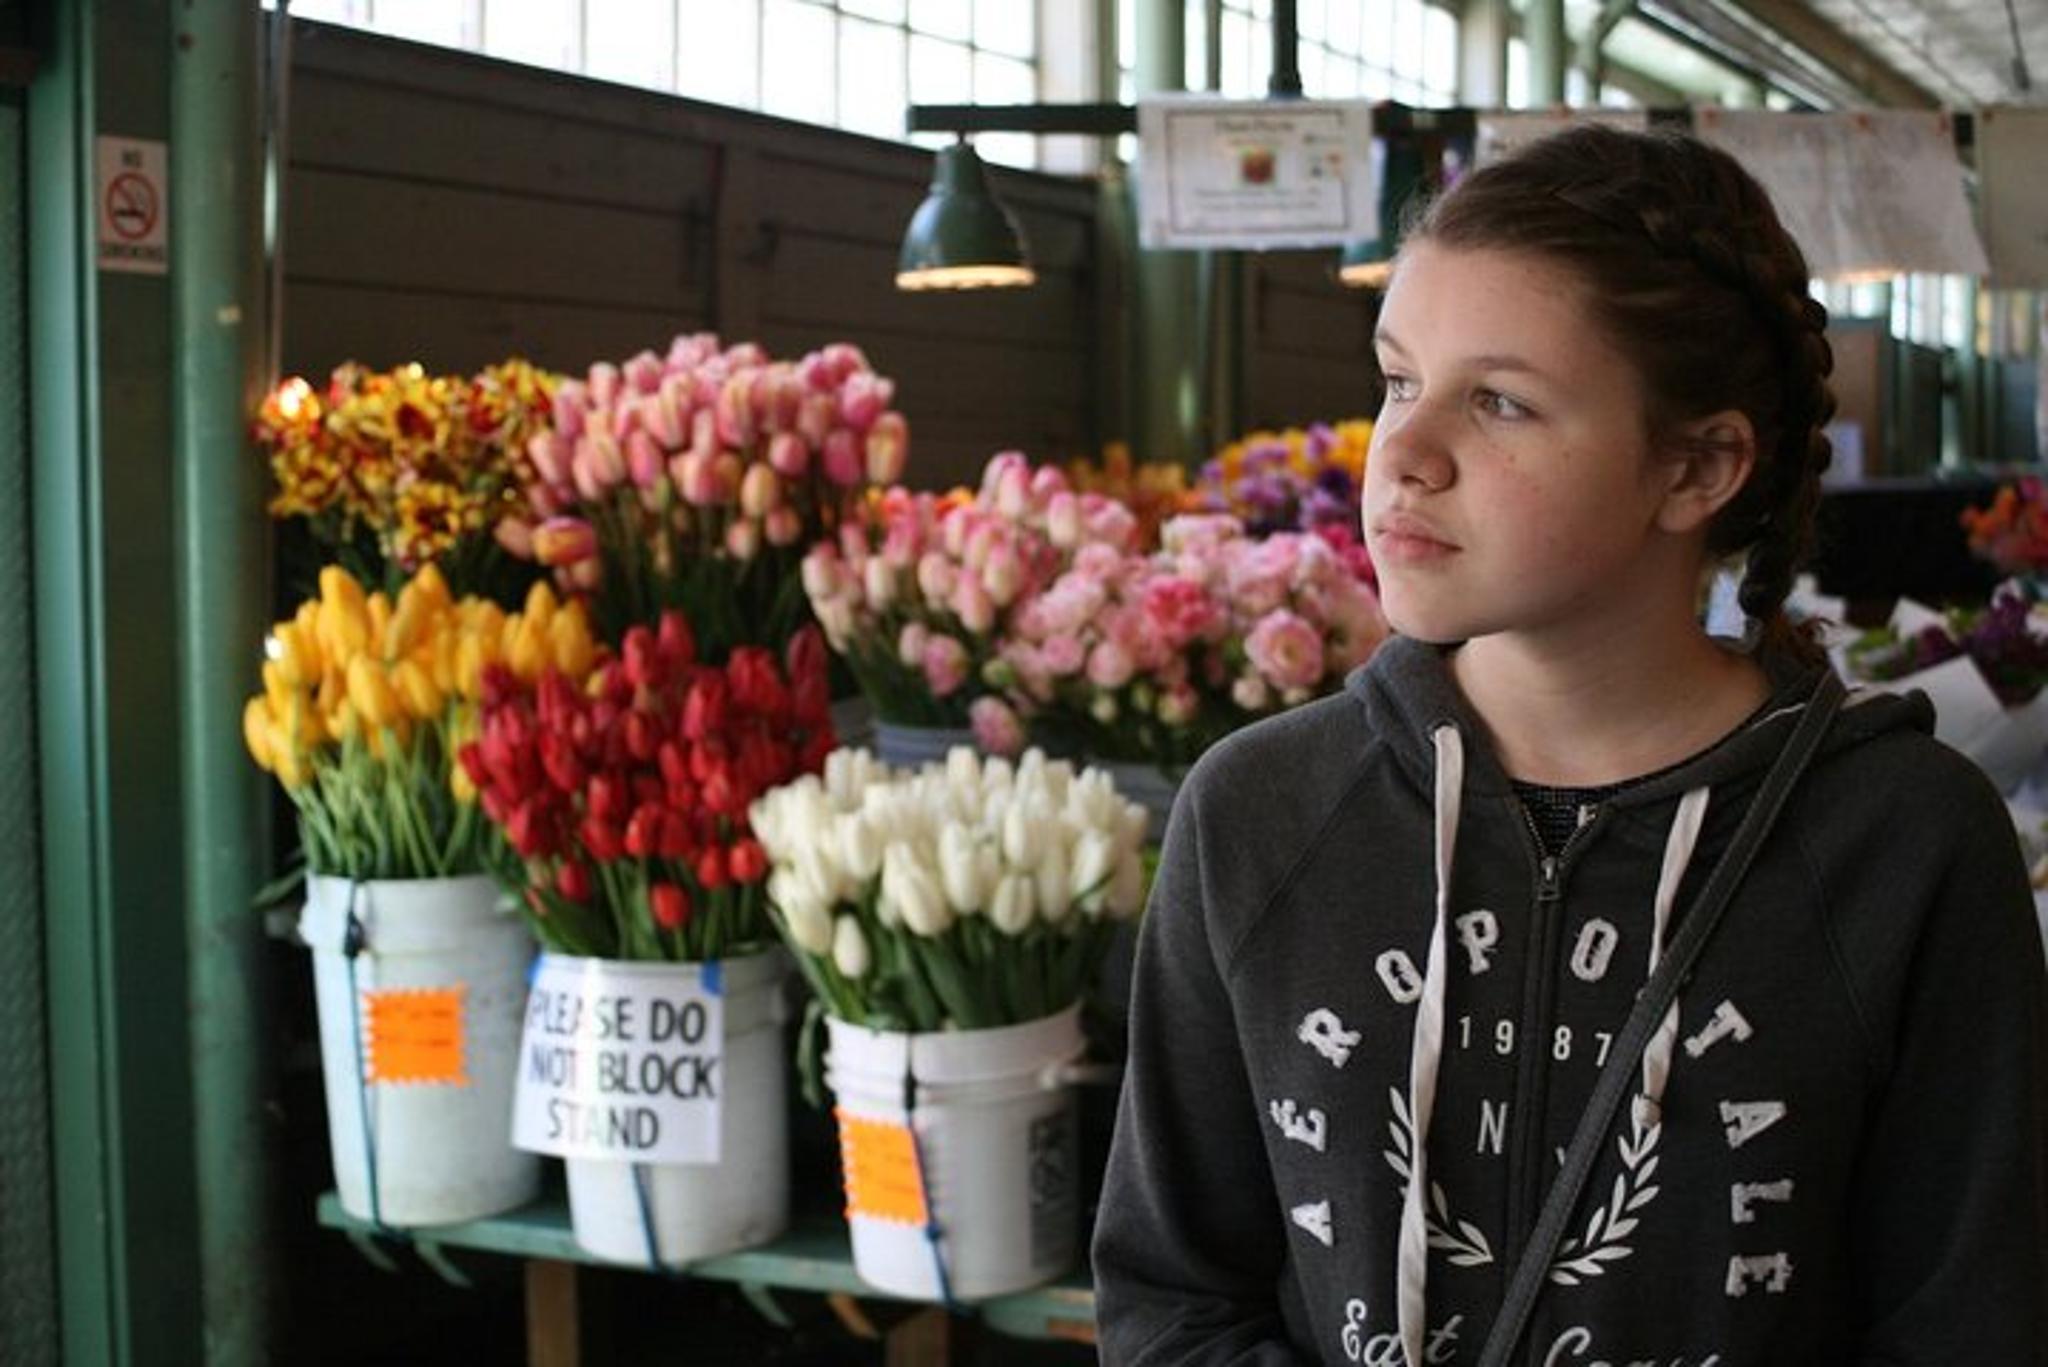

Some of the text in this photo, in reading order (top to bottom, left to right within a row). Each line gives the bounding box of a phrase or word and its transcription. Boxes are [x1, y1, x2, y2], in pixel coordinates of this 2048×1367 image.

[651, 998, 708, 1045] DO
[1459, 1016, 1613, 1067] 1987
[529, 1045, 720, 1099] NOT BLOCK
[547, 1097, 661, 1150] STAND
[1270, 908, 1794, 1297] AEROPOTALE
[1341, 1299, 1465, 1366] Eat
